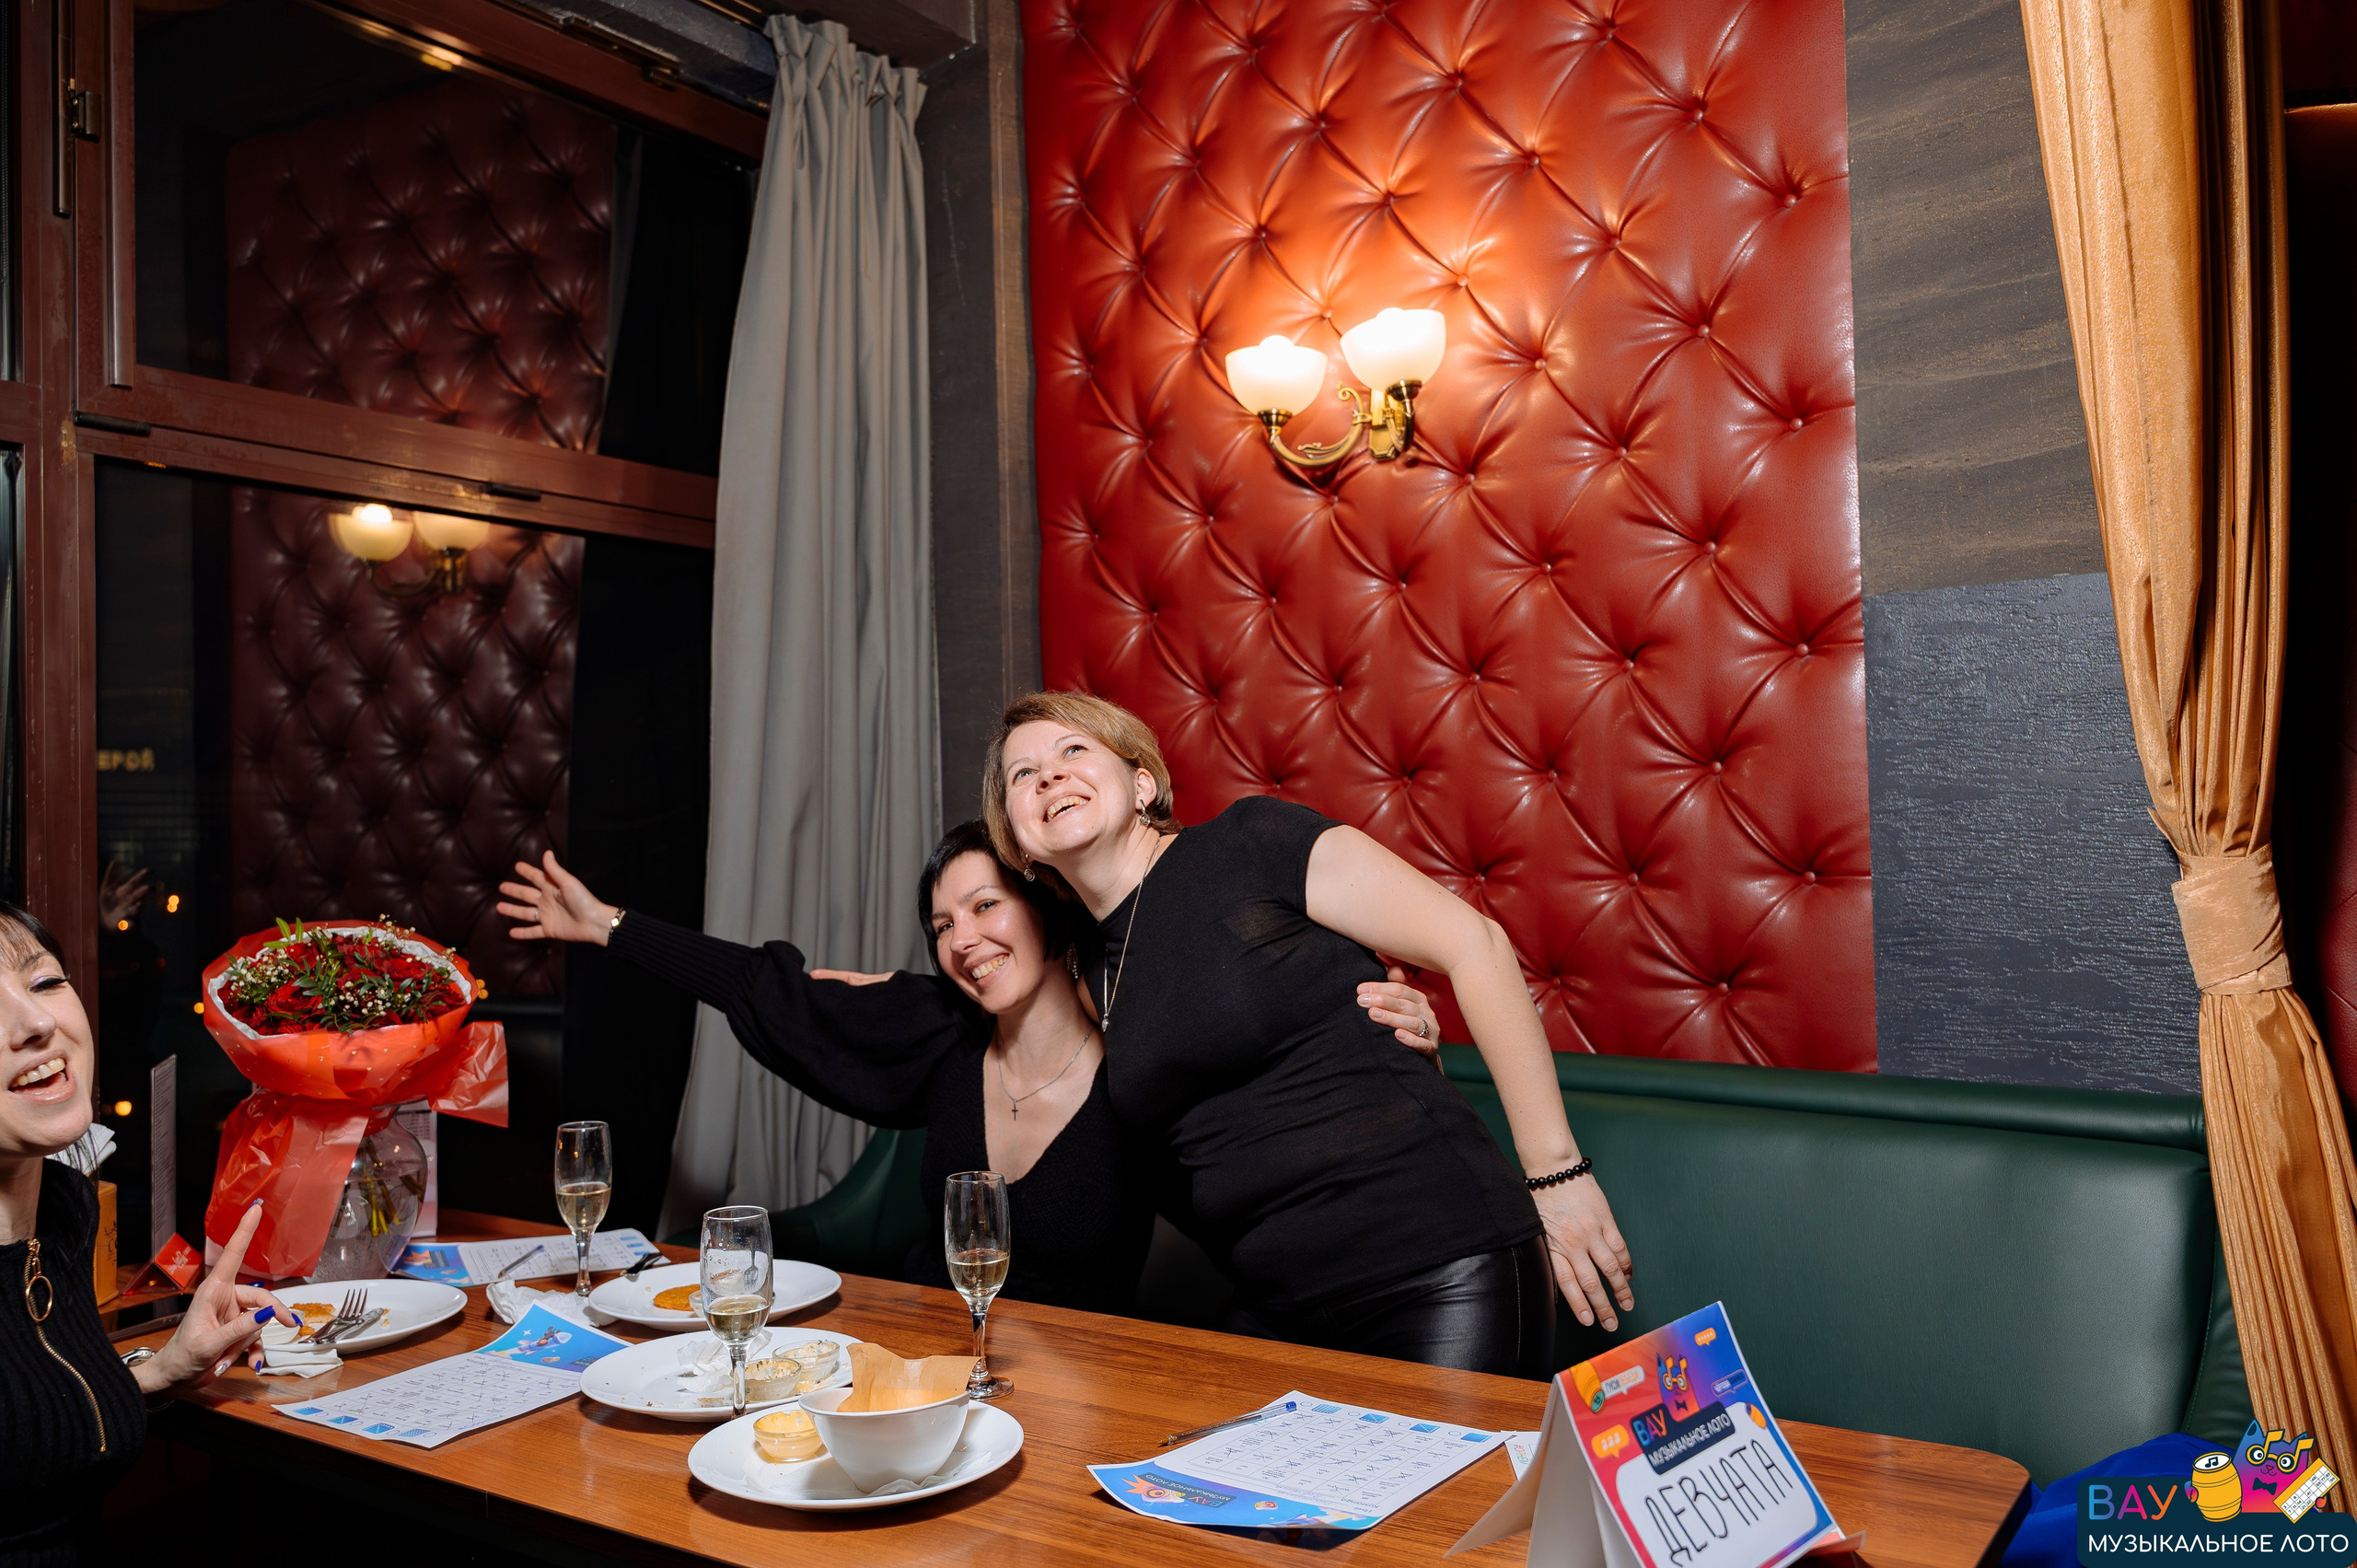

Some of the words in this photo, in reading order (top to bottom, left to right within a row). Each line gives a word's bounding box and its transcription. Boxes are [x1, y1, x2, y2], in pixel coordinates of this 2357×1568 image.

[1632, 1408, 1667, 1446] ВАУ
[1648, 1425, 1710, 1468] МУЗЫКАЛЬНОЕ
[1704, 1413, 1731, 1441] ЛОТО
[1145, 1473, 1168, 1485] ЛОТО
[1167, 1481, 1232, 1502] МУЗЫКАЛЬНОЕ
[1644, 1438, 1794, 1567] ДЕВЧАТА
